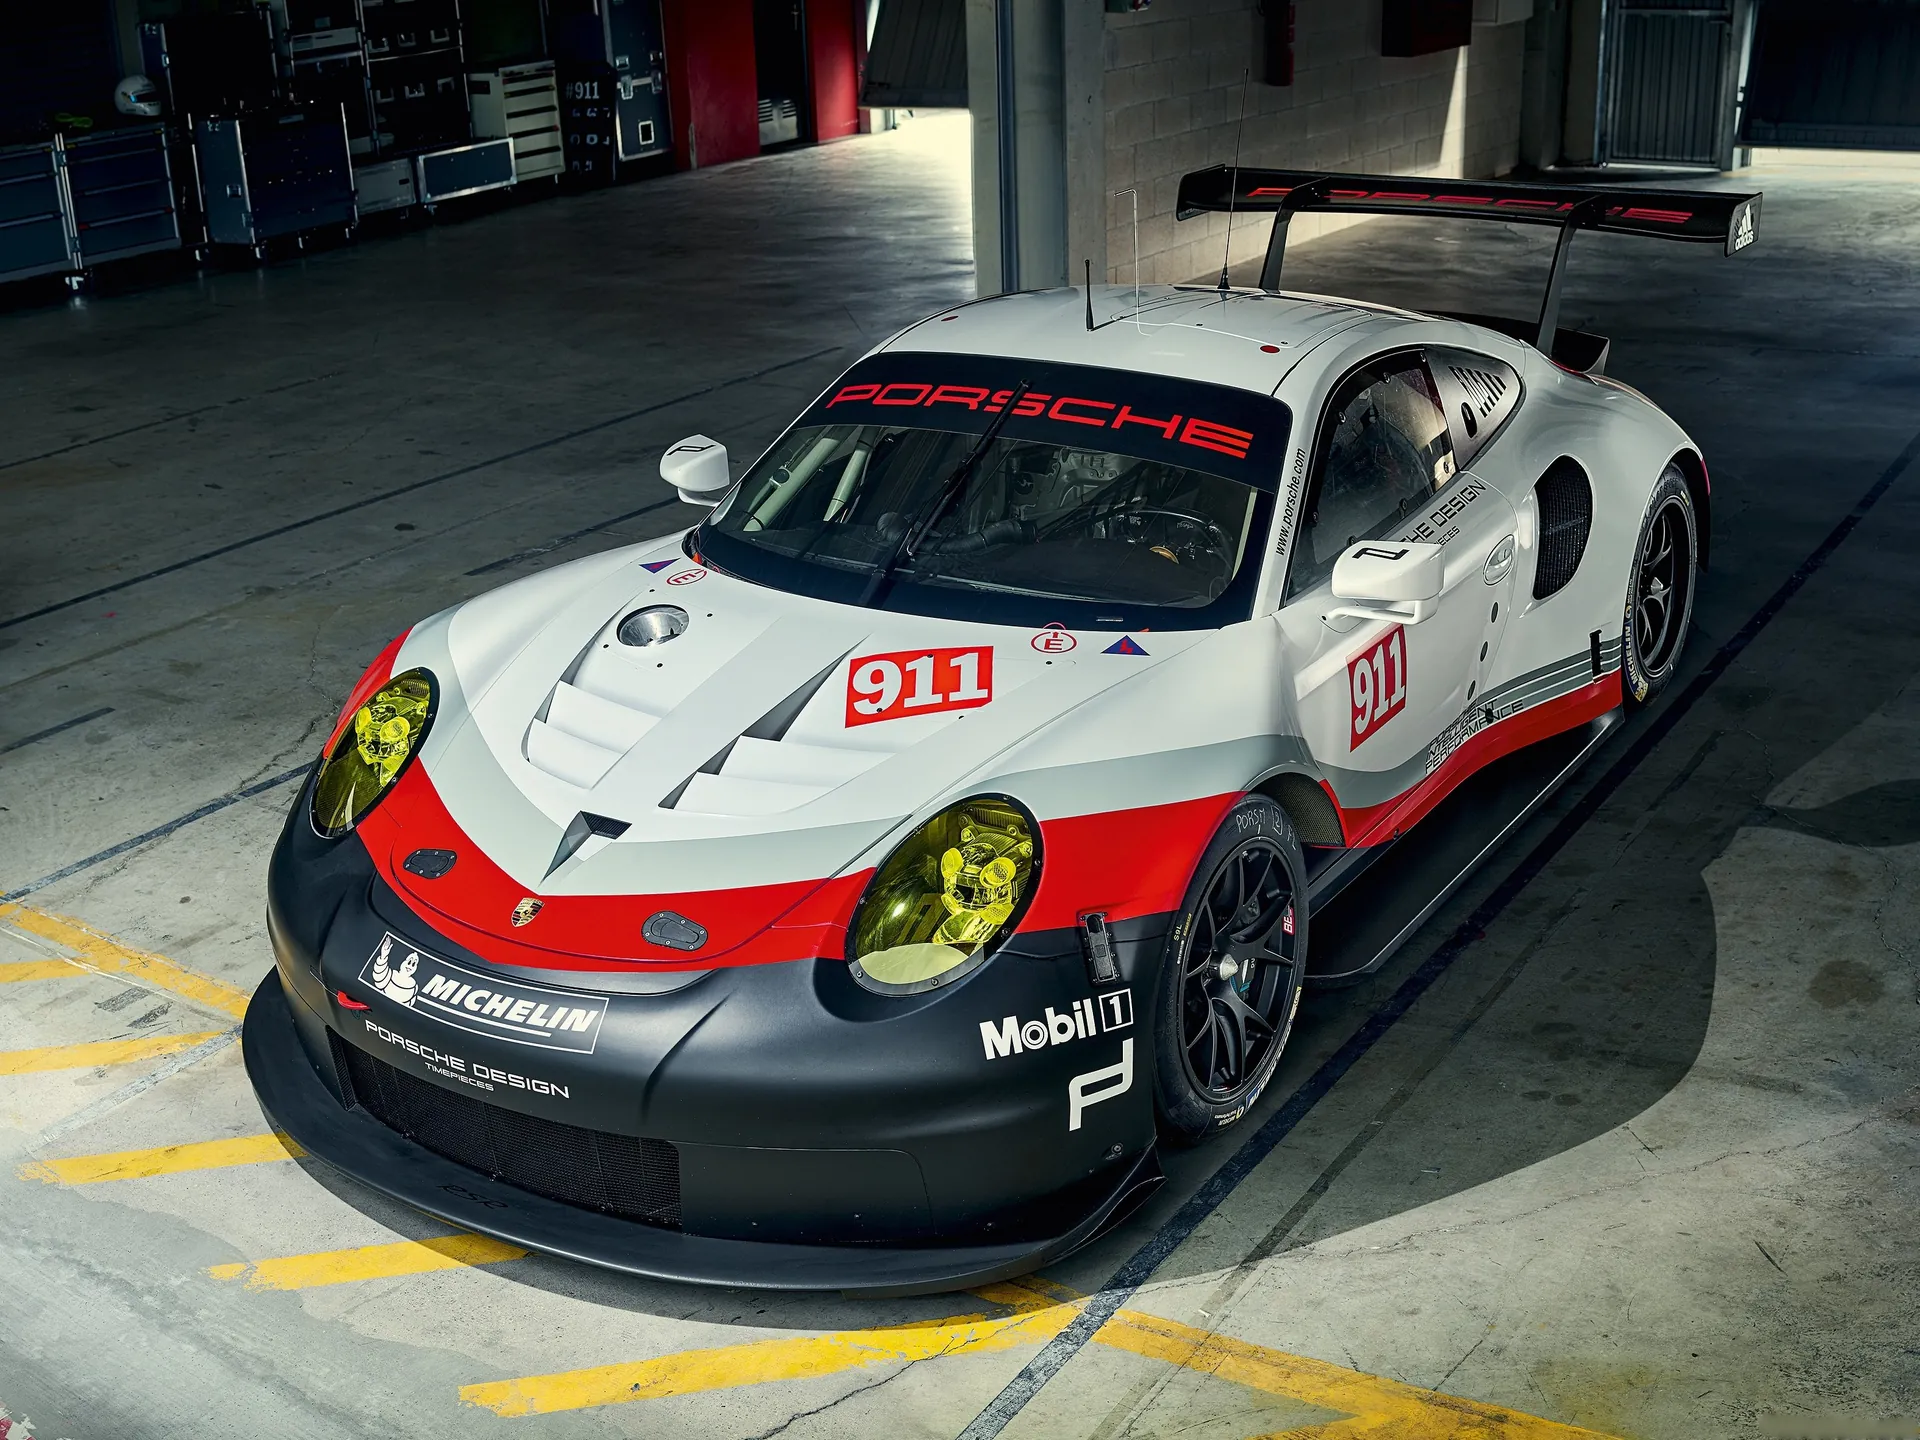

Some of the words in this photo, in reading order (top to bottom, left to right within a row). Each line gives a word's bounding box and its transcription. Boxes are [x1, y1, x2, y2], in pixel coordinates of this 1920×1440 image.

[565, 81, 600, 99] #911
[825, 383, 1254, 459] PORSCHE
[1276, 448, 1306, 556] www.porsche.com
[1429, 480, 1487, 528] DESIGN
[852, 652, 989, 715] 911
[1353, 631, 1406, 735] 911
[1624, 625, 1639, 685] MICHELIN
[422, 973, 599, 1033] MICHELIN
[979, 998, 1097, 1061] Mobil
[1109, 995, 1123, 1025] 1
[365, 1019, 467, 1073] PORSCHE
[472, 1063, 570, 1100] DESIGN
[425, 1061, 495, 1092] TIMEPIECES
